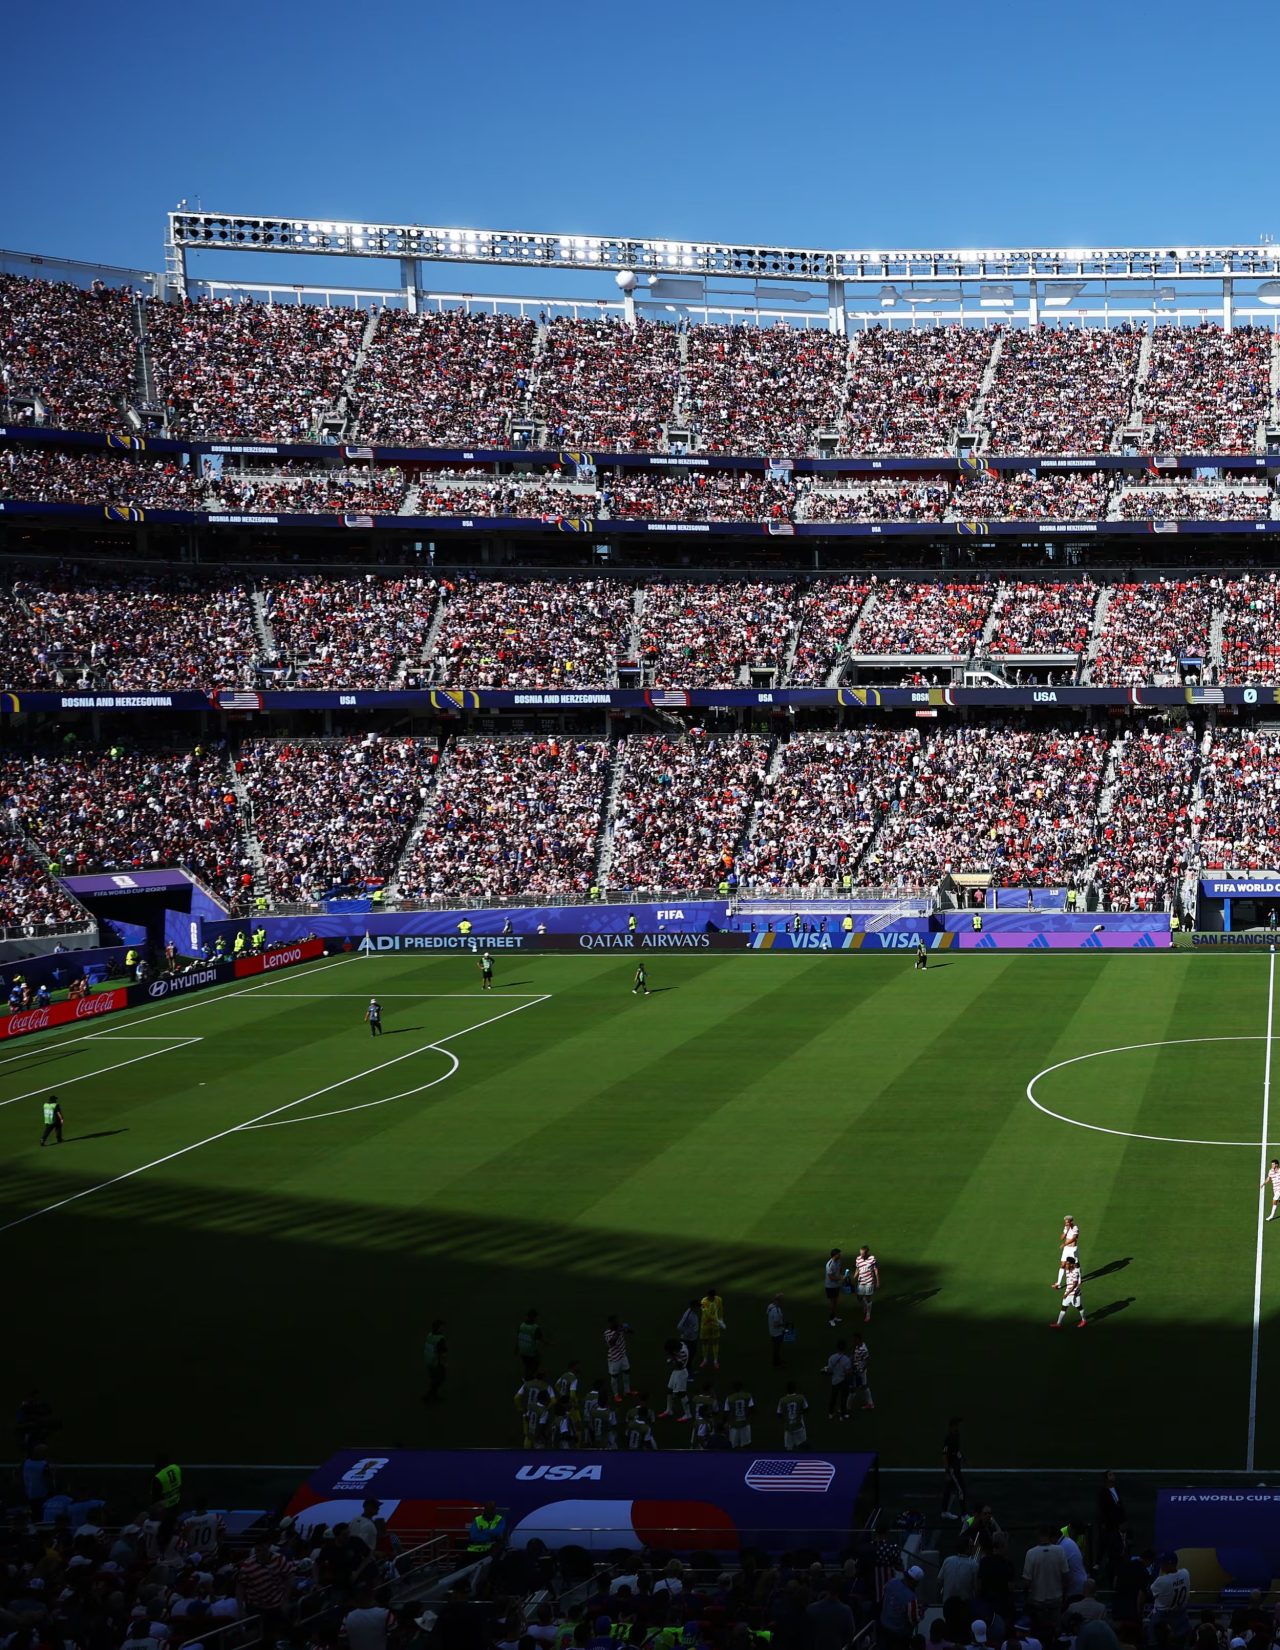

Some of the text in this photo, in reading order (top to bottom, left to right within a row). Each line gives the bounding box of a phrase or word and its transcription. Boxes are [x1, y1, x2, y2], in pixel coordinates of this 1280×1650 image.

[62, 697, 172, 707] BOSNIA AND HERZEGOVINA
[340, 696, 356, 705] USA
[514, 695, 610, 704] BOSNIA AND HERZEGOVINA
[758, 694, 772, 702] USA
[1034, 692, 1056, 702] USA
[1244, 689, 1257, 702] 0
[1214, 884, 1236, 892] FIFA
[1237, 884, 1275, 892] WORLD
[657, 911, 684, 920] FIFA
[358, 937, 523, 950] ADI PREDICTSTREET
[580, 934, 710, 948] QATAR AIRWAYS
[790, 933, 832, 948] VISA
[876, 933, 920, 948] VISA
[1192, 934, 1218, 945] SAN
[263, 949, 301, 968] Lenovo
[170, 969, 216, 991] HYUNDAI
[515, 1465, 602, 1480] USA
[194, 1527, 212, 1546] 10
[1172, 1586, 1187, 1607] 10
